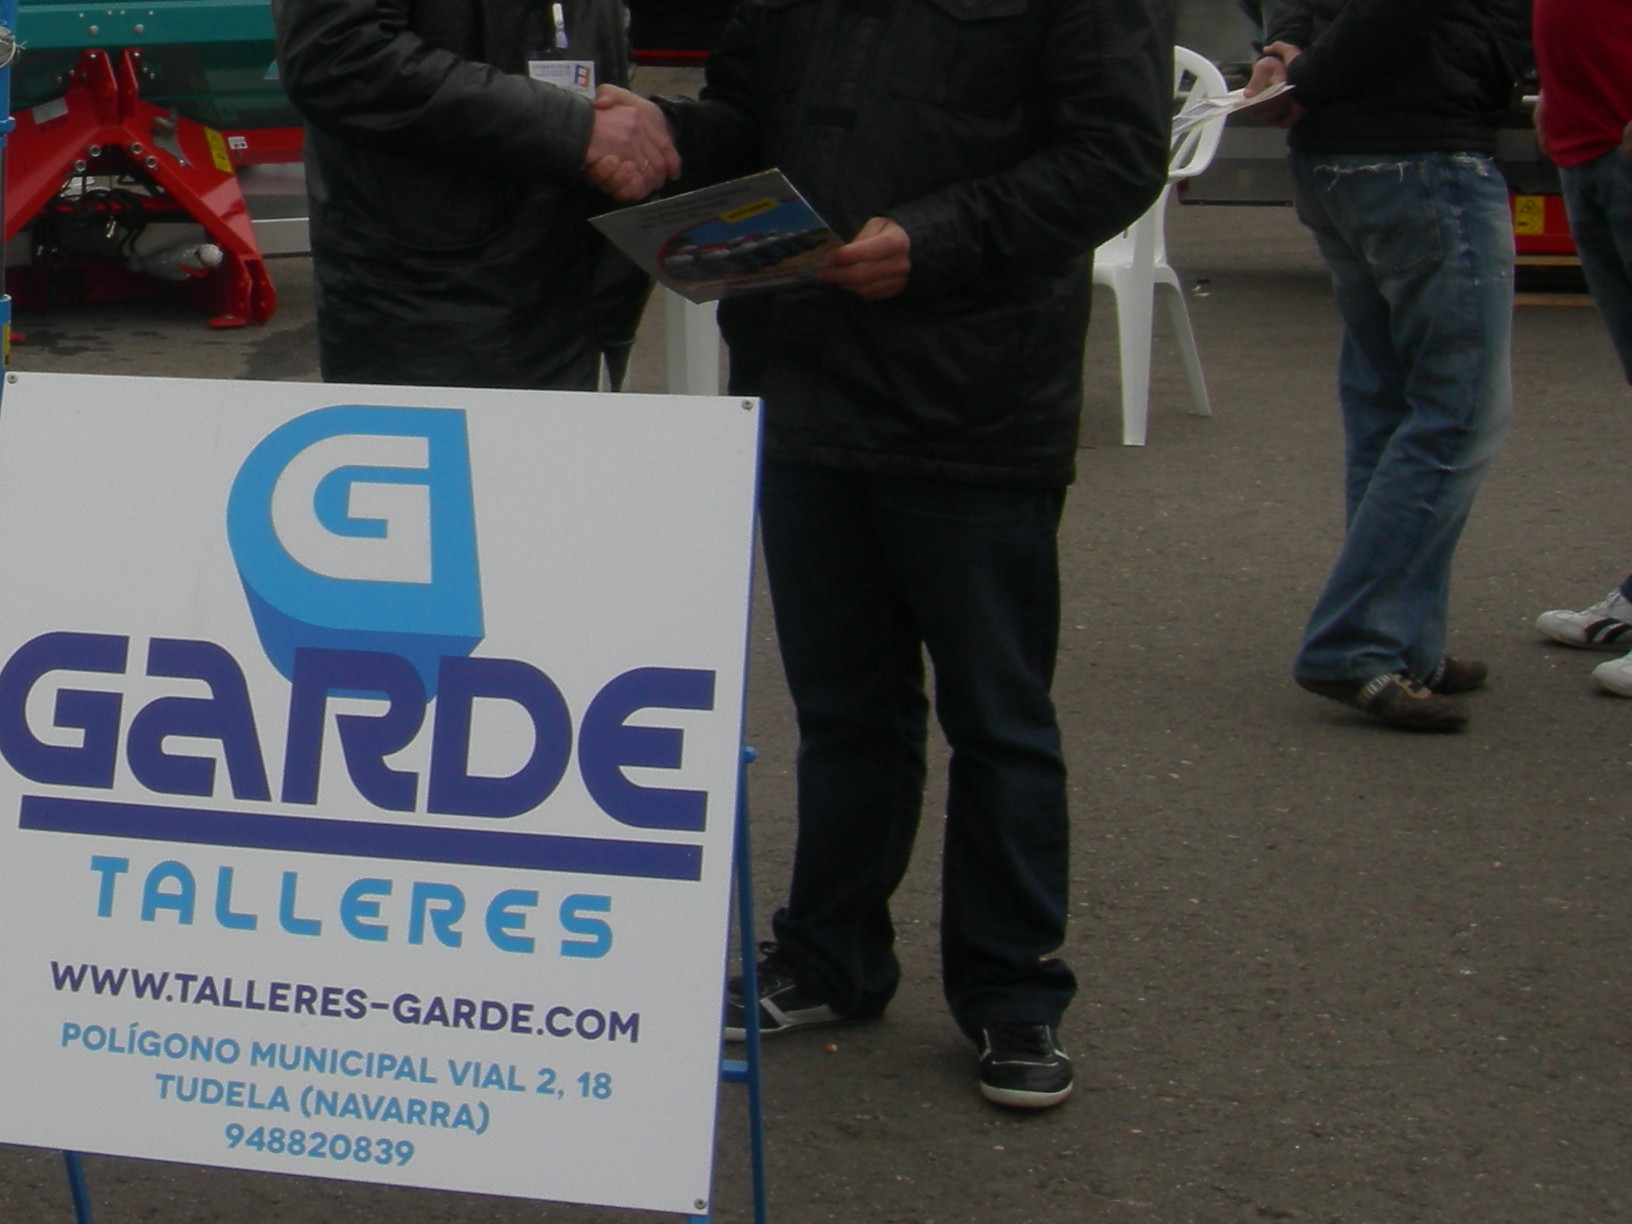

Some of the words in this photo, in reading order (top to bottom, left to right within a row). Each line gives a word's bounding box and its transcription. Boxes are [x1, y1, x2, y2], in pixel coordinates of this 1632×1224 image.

[90, 855, 614, 960] TALLERES
[50, 960, 641, 1044] WWW.TALLERES-GARDE.COM
[60, 1021, 241, 1065] POLÍGONO
[249, 1040, 438, 1085] MUNICIPAL
[447, 1059, 526, 1093] VIAL
[535, 1067, 565, 1101] 2,
[576, 1071, 613, 1100] 18
[154, 1073, 291, 1113] TUDELA
[299, 1084, 491, 1136] (NAVARRA)
[224, 1122, 416, 1167] 948820839
